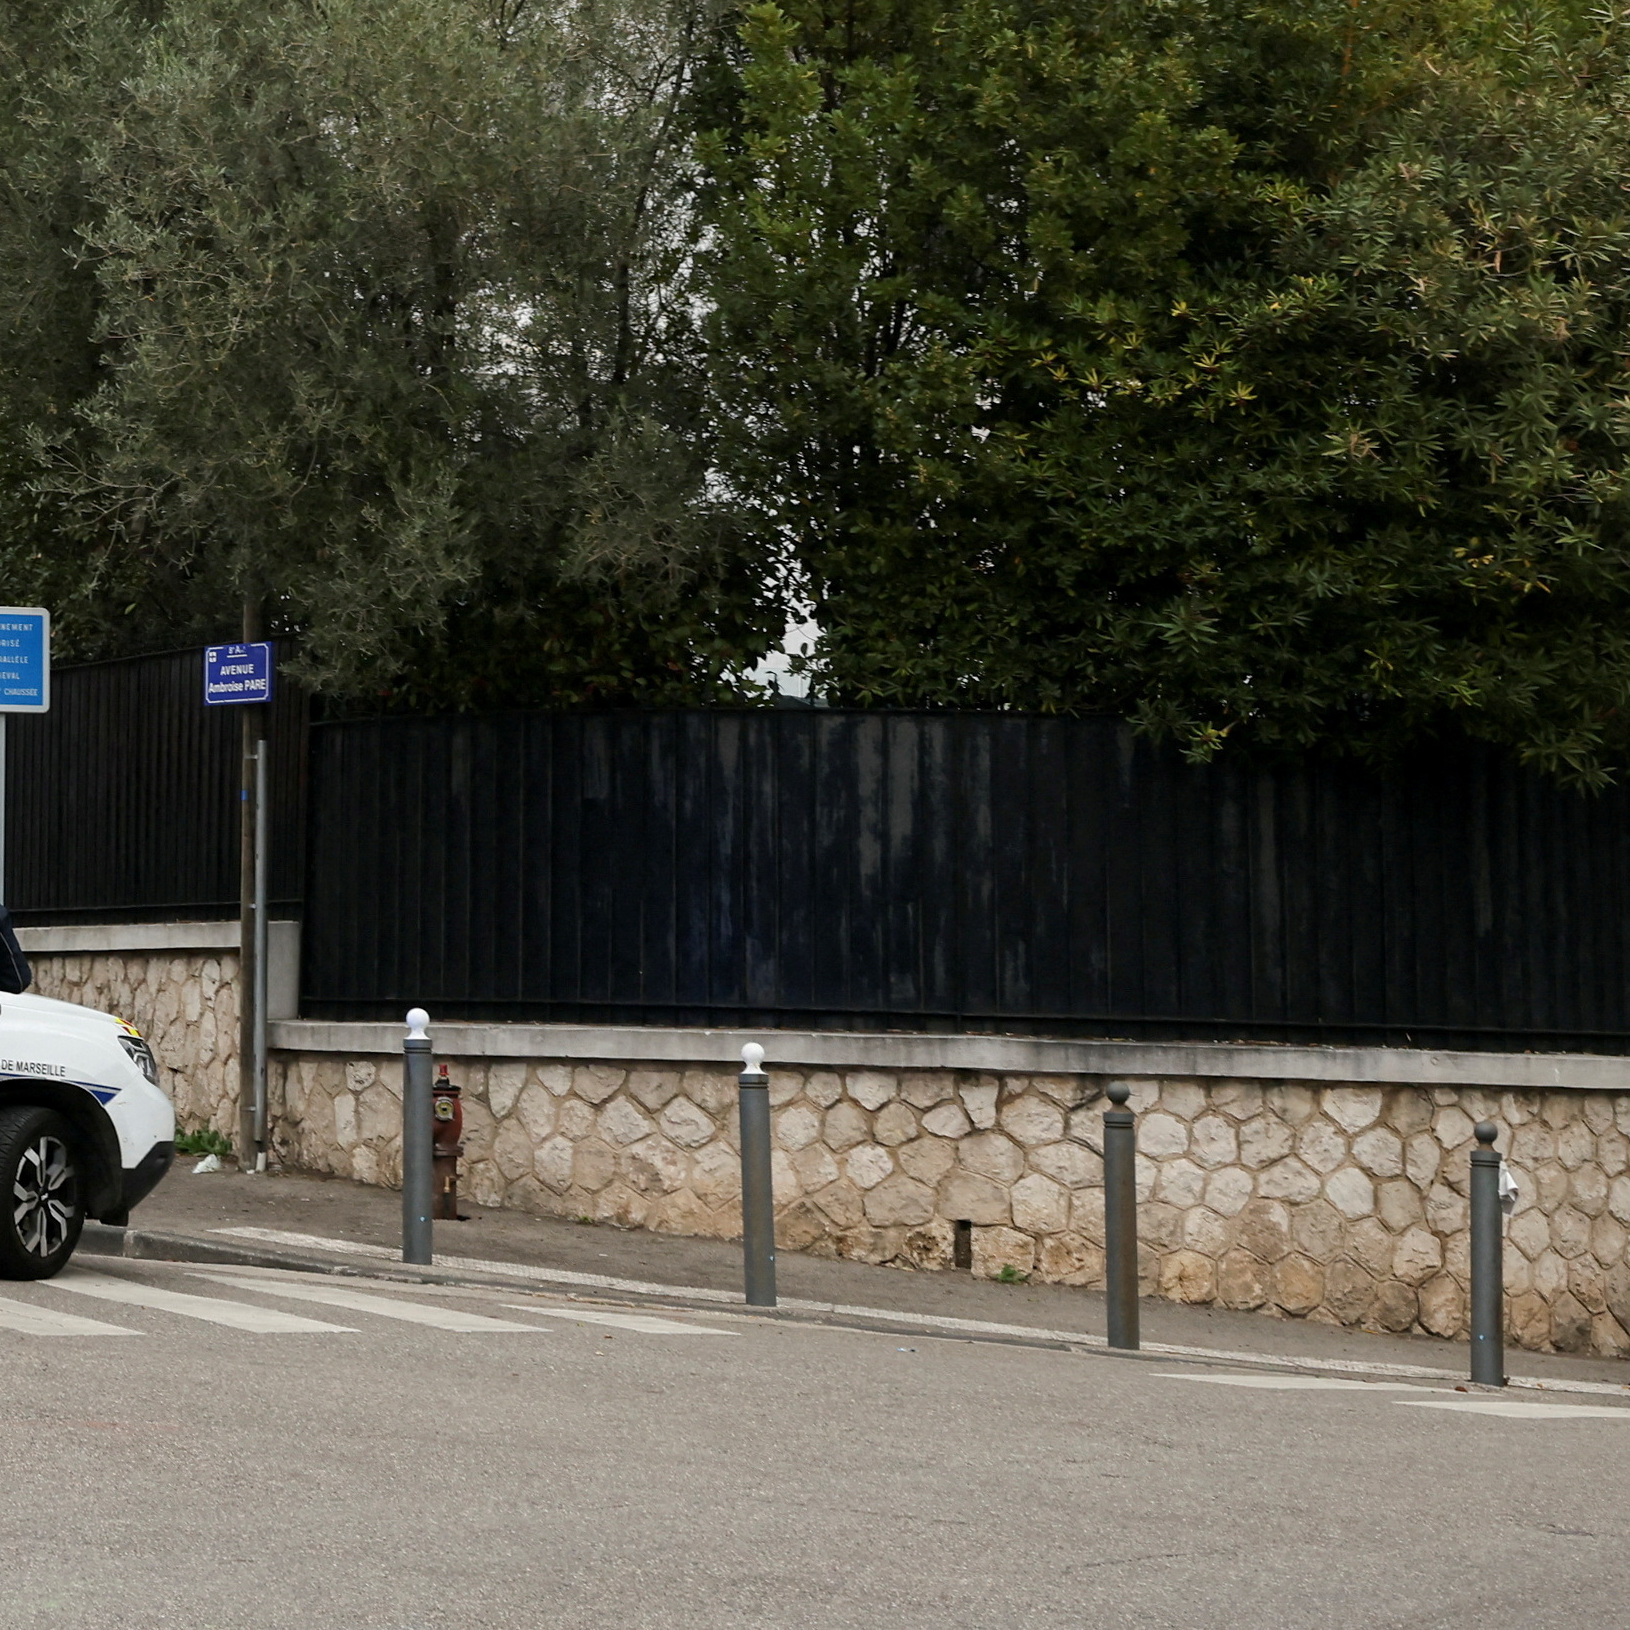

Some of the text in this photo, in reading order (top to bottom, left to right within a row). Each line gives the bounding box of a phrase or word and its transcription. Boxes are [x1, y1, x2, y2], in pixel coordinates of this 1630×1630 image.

[220, 663, 255, 676] AVENUE
[208, 681, 243, 693] Ambroise
[1, 1058, 14, 1071] DE
[15, 1060, 66, 1077] MARSEILLE
